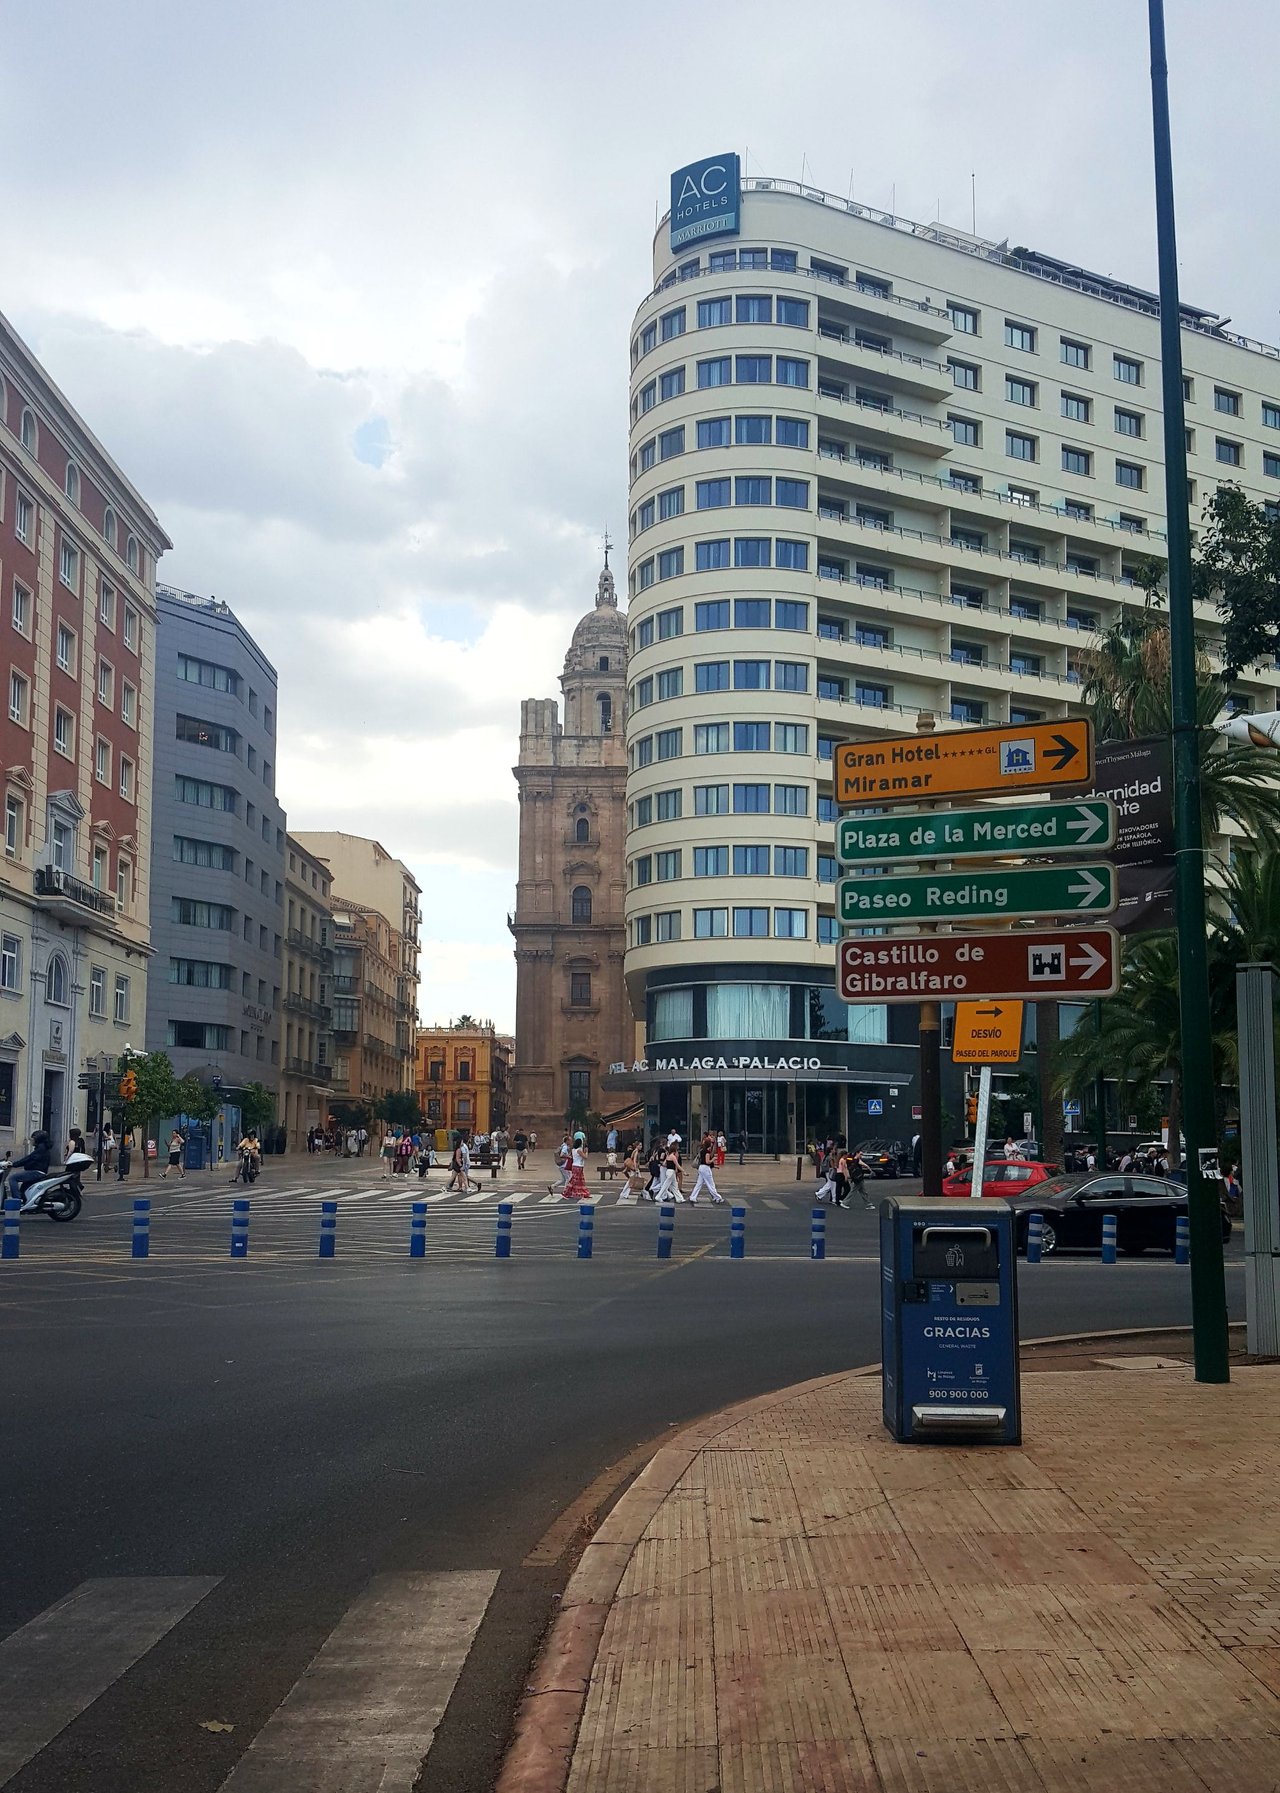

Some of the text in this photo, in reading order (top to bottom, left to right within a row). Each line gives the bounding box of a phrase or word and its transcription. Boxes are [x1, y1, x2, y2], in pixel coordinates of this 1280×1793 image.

[677, 165, 728, 207] AC
[677, 196, 728, 220] HOTELS
[677, 218, 728, 242] MARRIOTT
[844, 743, 997, 768] Gran Hotel GL
[1013, 752, 1023, 764] H
[844, 773, 933, 794] Miramar
[1066, 775, 1162, 801] dernidad
[1116, 800, 1140, 816] nte
[844, 817, 1057, 850] Plaza de la Merced
[844, 885, 1008, 910] Paseo Reding
[845, 943, 985, 966] Castillo de
[845, 971, 967, 992] Gibralfaro
[971, 1026, 1002, 1038] DESVÍO
[956, 1049, 1017, 1058] PASEO DEL PARQUE
[631, 1059, 649, 1073] AC
[656, 1056, 728, 1070] MALAGA
[739, 1056, 821, 1070] PALACIO
[924, 1326, 990, 1338] GRACIAS
[929, 1390, 989, 1398] 900 900 000
